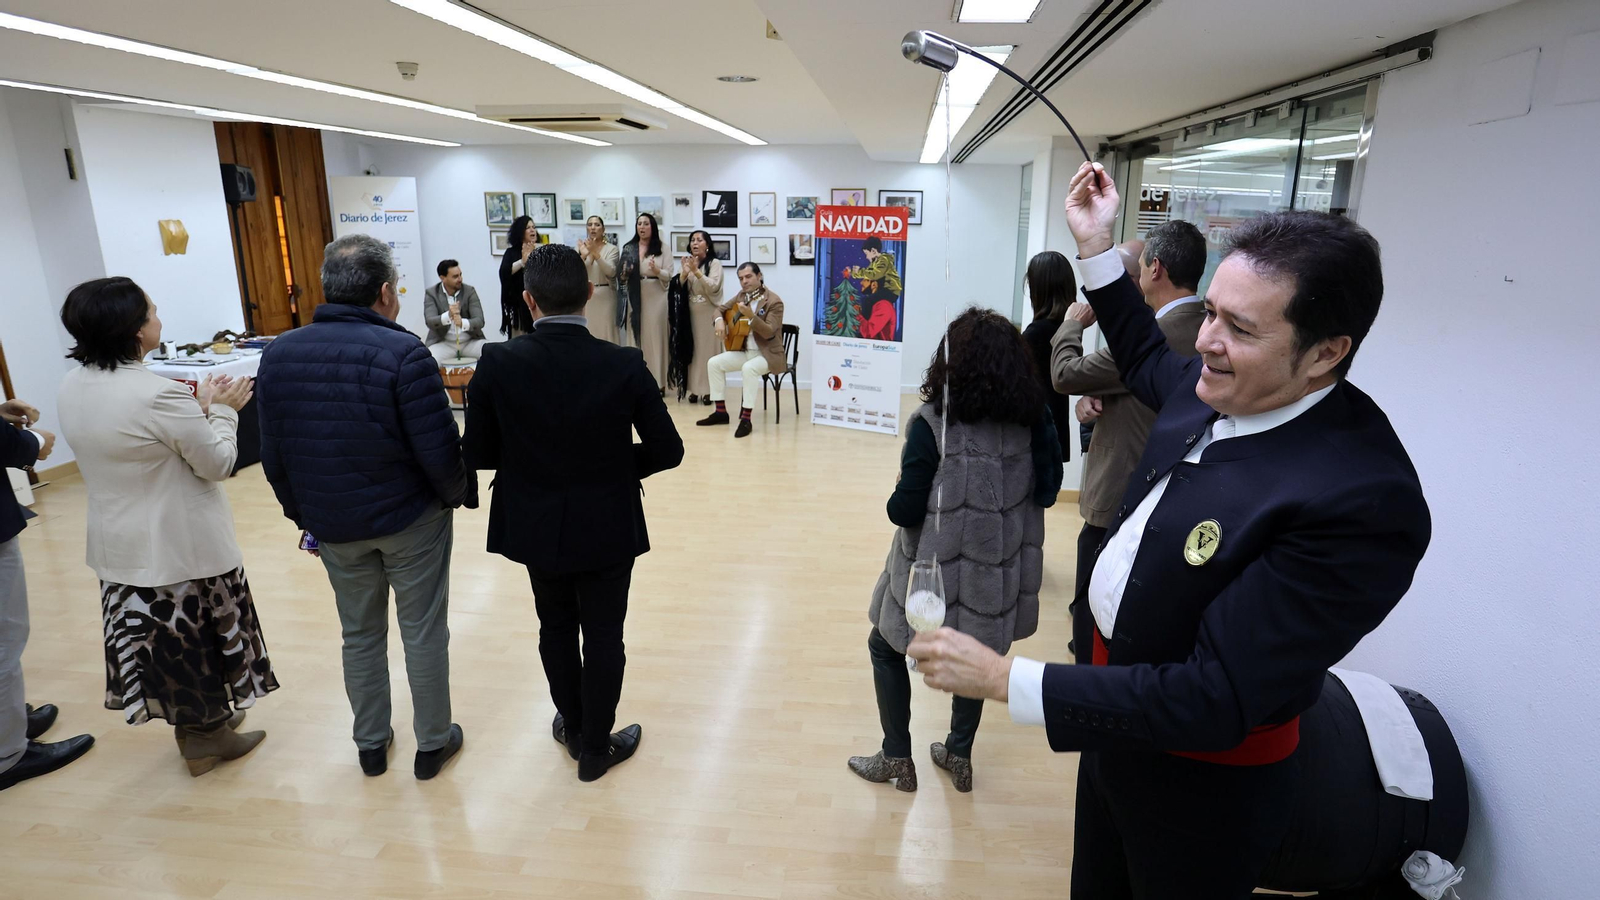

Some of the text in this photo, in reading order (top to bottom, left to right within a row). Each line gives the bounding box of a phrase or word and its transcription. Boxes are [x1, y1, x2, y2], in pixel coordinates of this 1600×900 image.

[340, 212, 408, 225] Diario de Jerez
[820, 214, 903, 234] NAVIDAD
